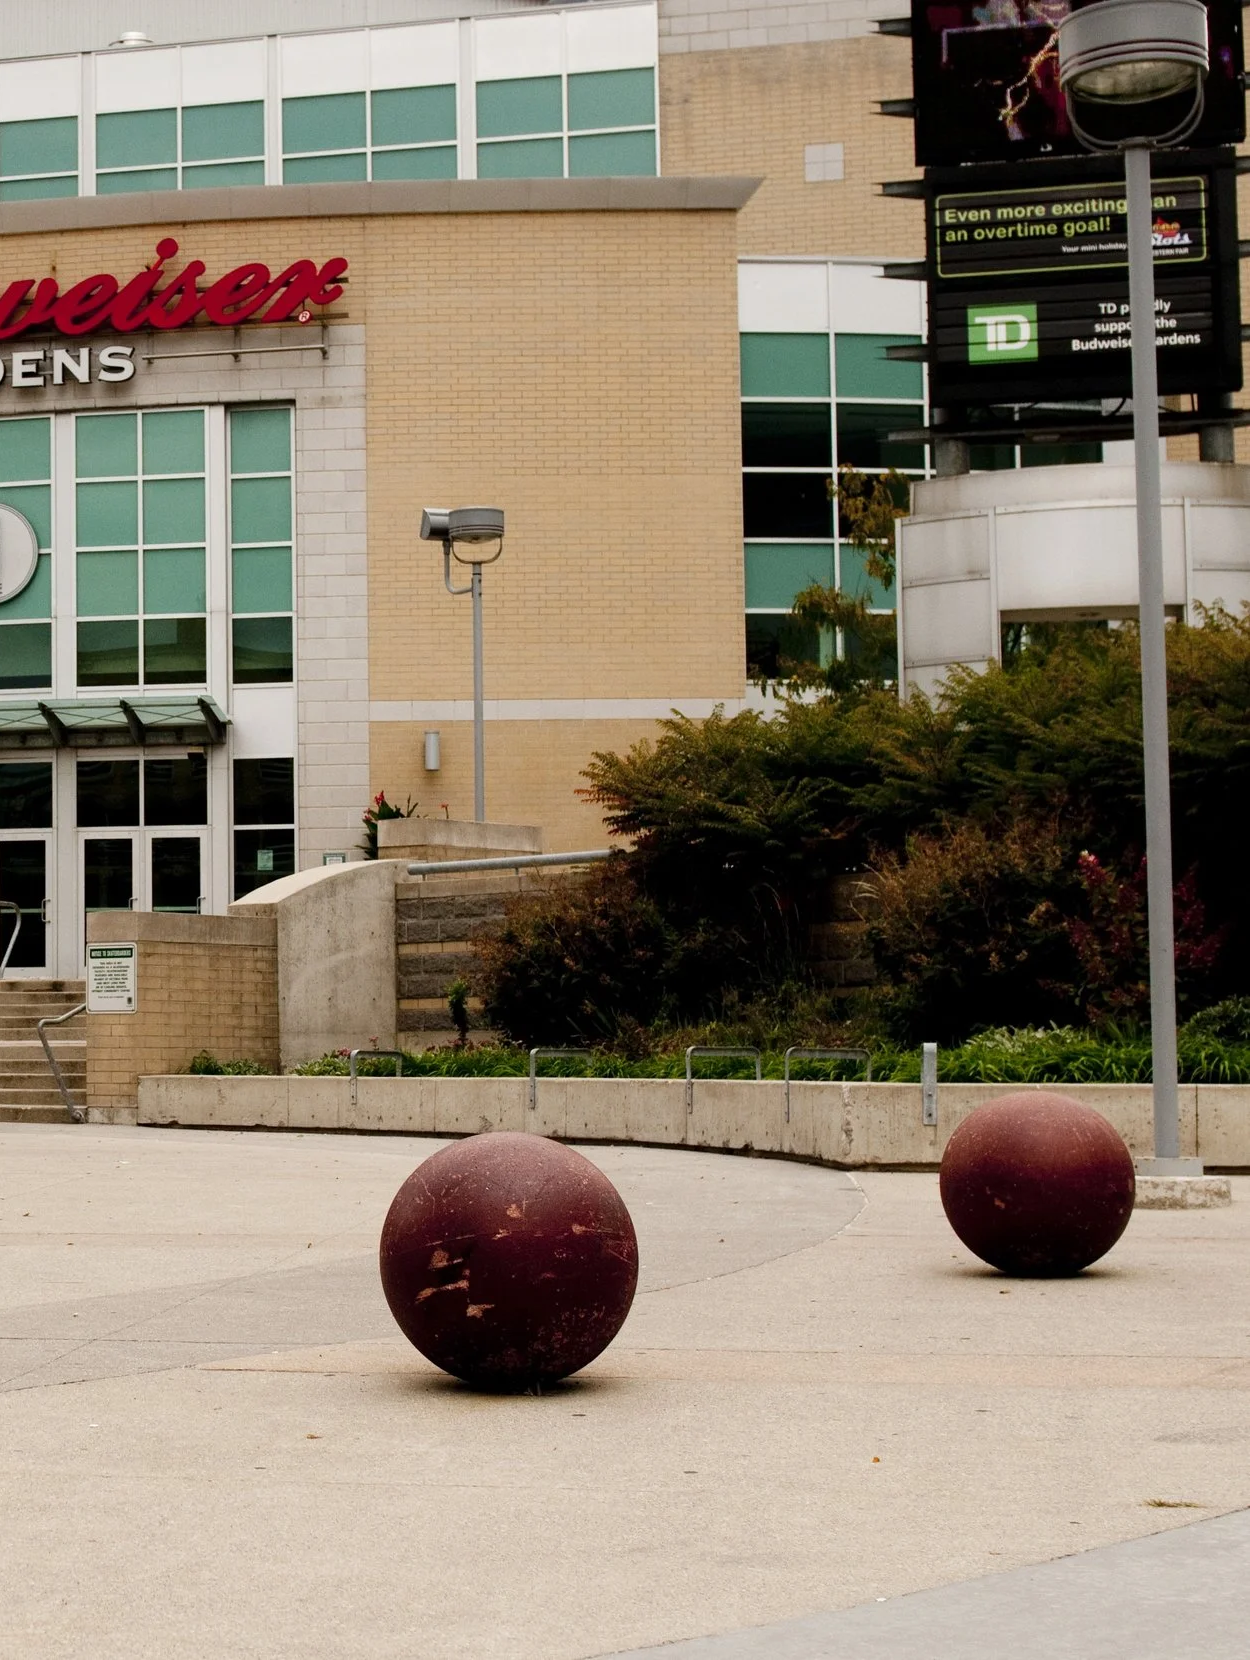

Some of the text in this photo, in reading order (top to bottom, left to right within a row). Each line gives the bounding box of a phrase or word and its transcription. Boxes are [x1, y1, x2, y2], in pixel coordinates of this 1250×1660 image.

[944, 195, 1177, 223] Even more exciting an
[945, 216, 1111, 242] an overtime goal!
[1098, 303, 1117, 315] TD
[1155, 316, 1178, 329] the
[974, 314, 1031, 352] TD
[1155, 333, 1201, 346] ardens
